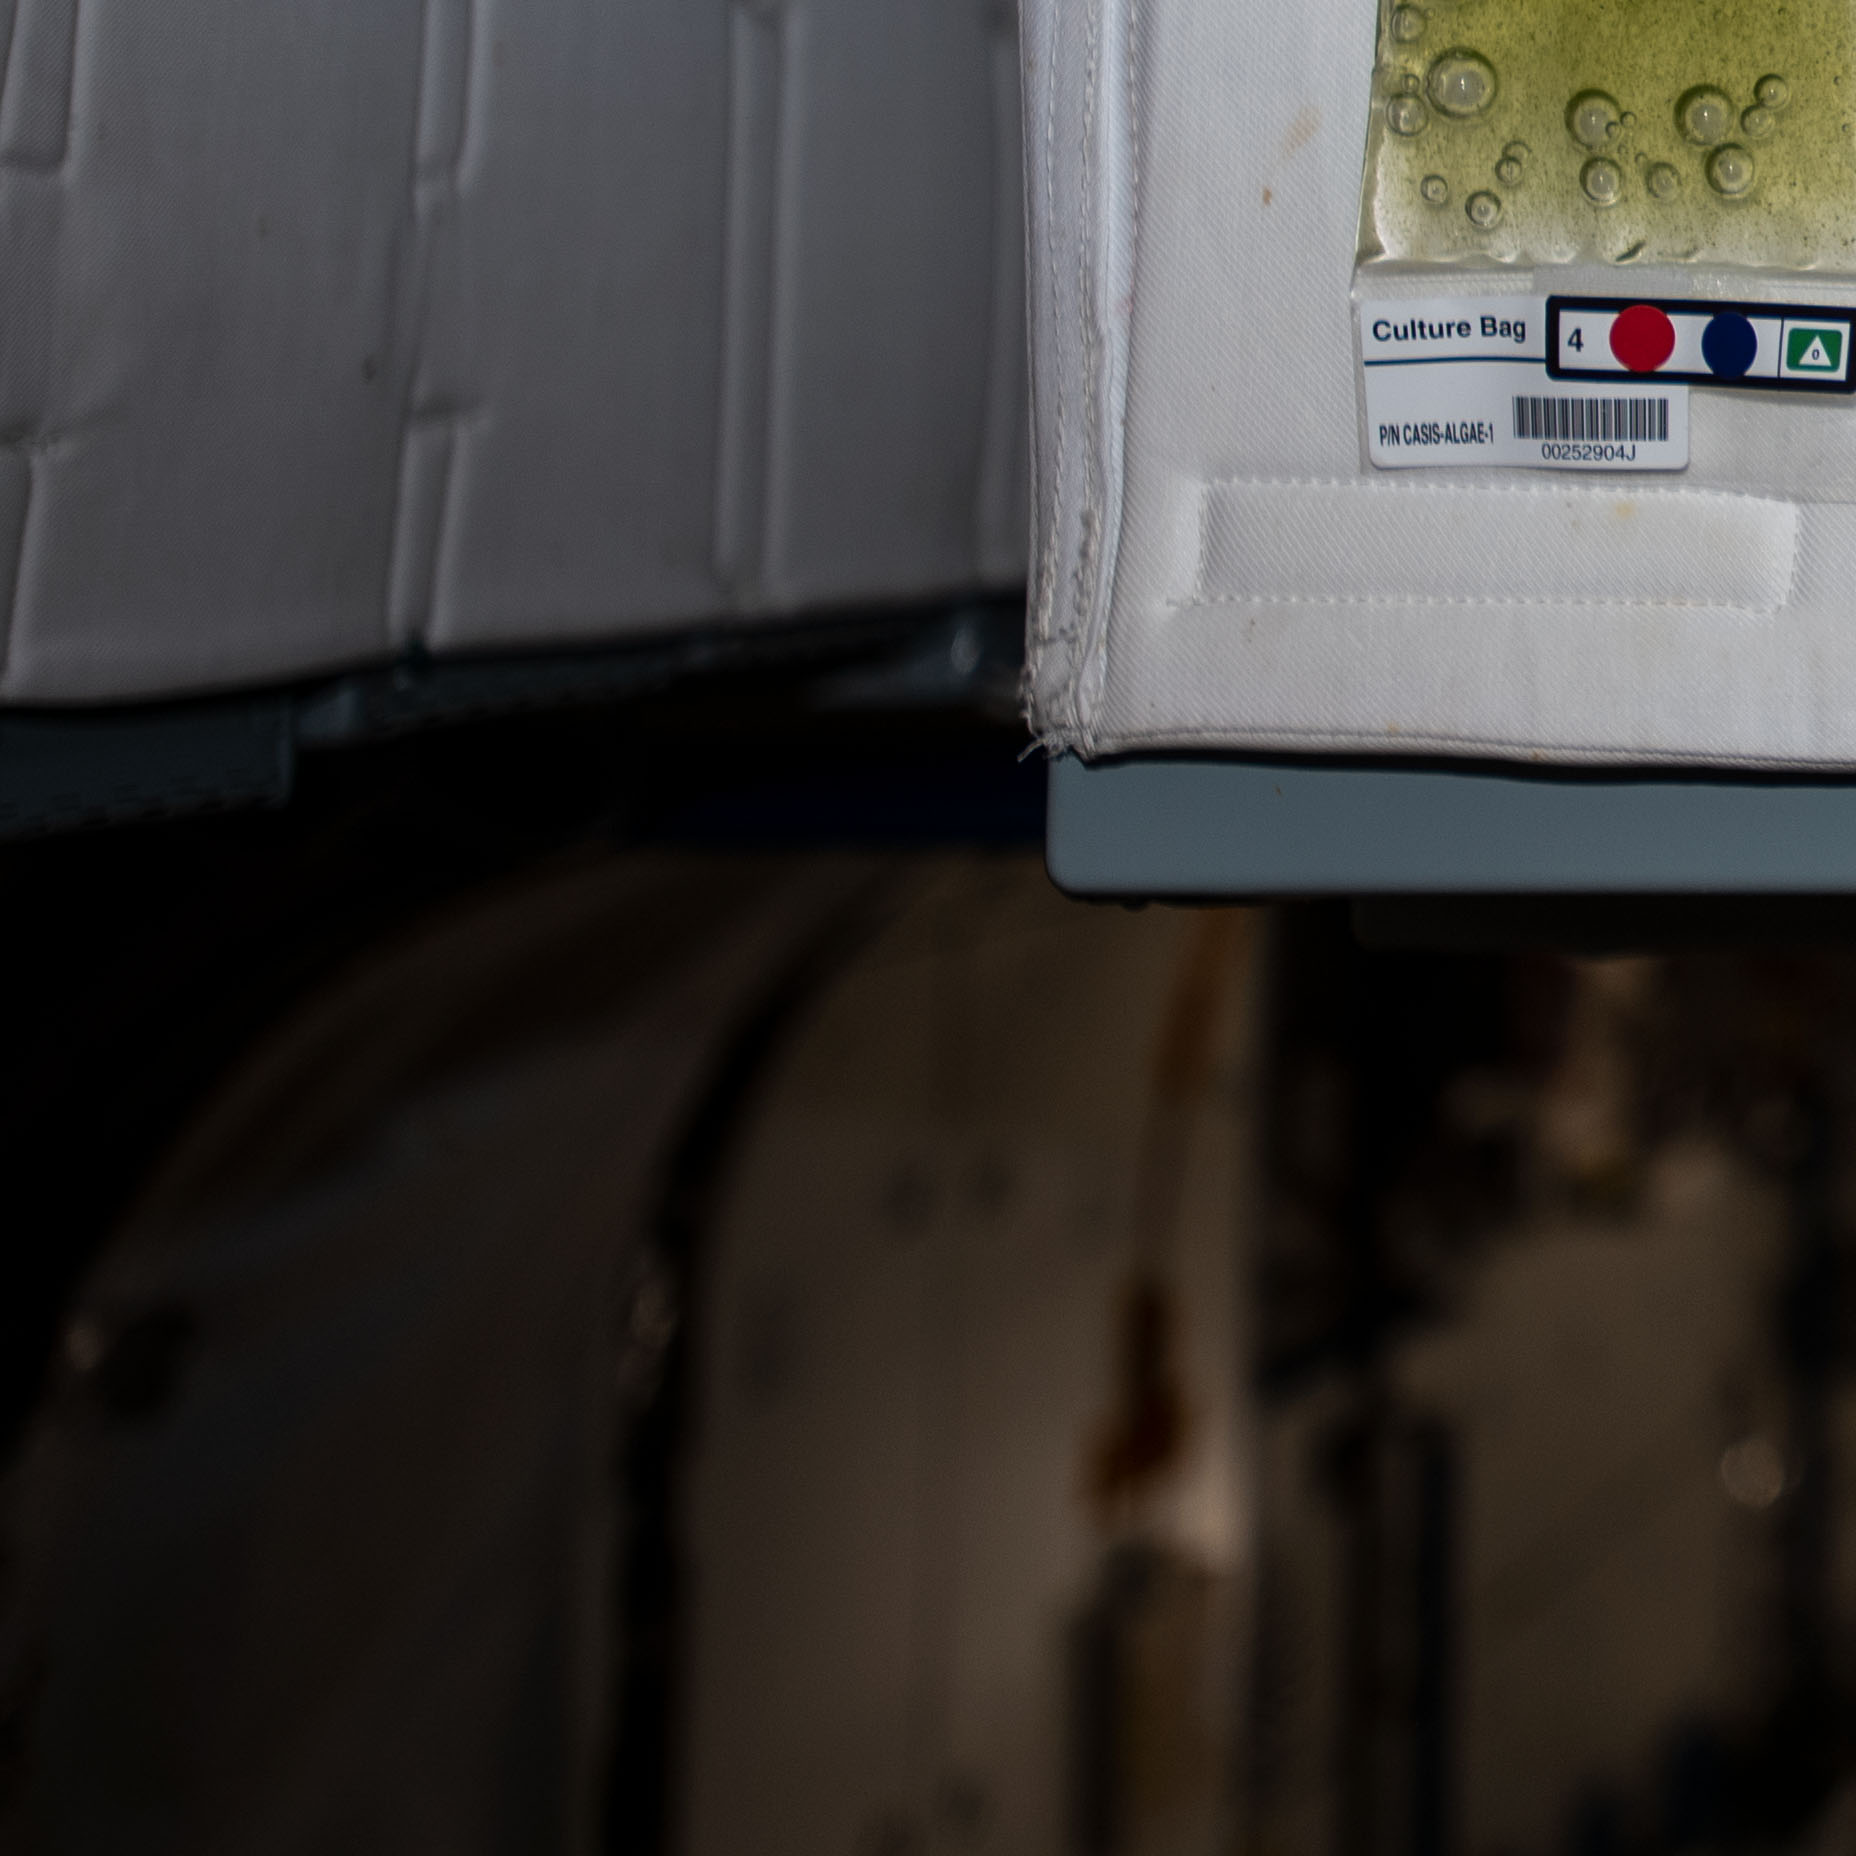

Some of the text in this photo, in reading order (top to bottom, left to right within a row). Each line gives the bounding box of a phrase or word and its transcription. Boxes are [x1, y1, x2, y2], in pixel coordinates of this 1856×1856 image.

[1373, 316, 1526, 343] Culture Bag
[1567, 328, 1584, 352] 4
[1812, 349, 1821, 361] 0
[1379, 421, 1495, 447] P/N CASIS-ALGAE-1
[1541, 444, 1637, 463] 00252904J
